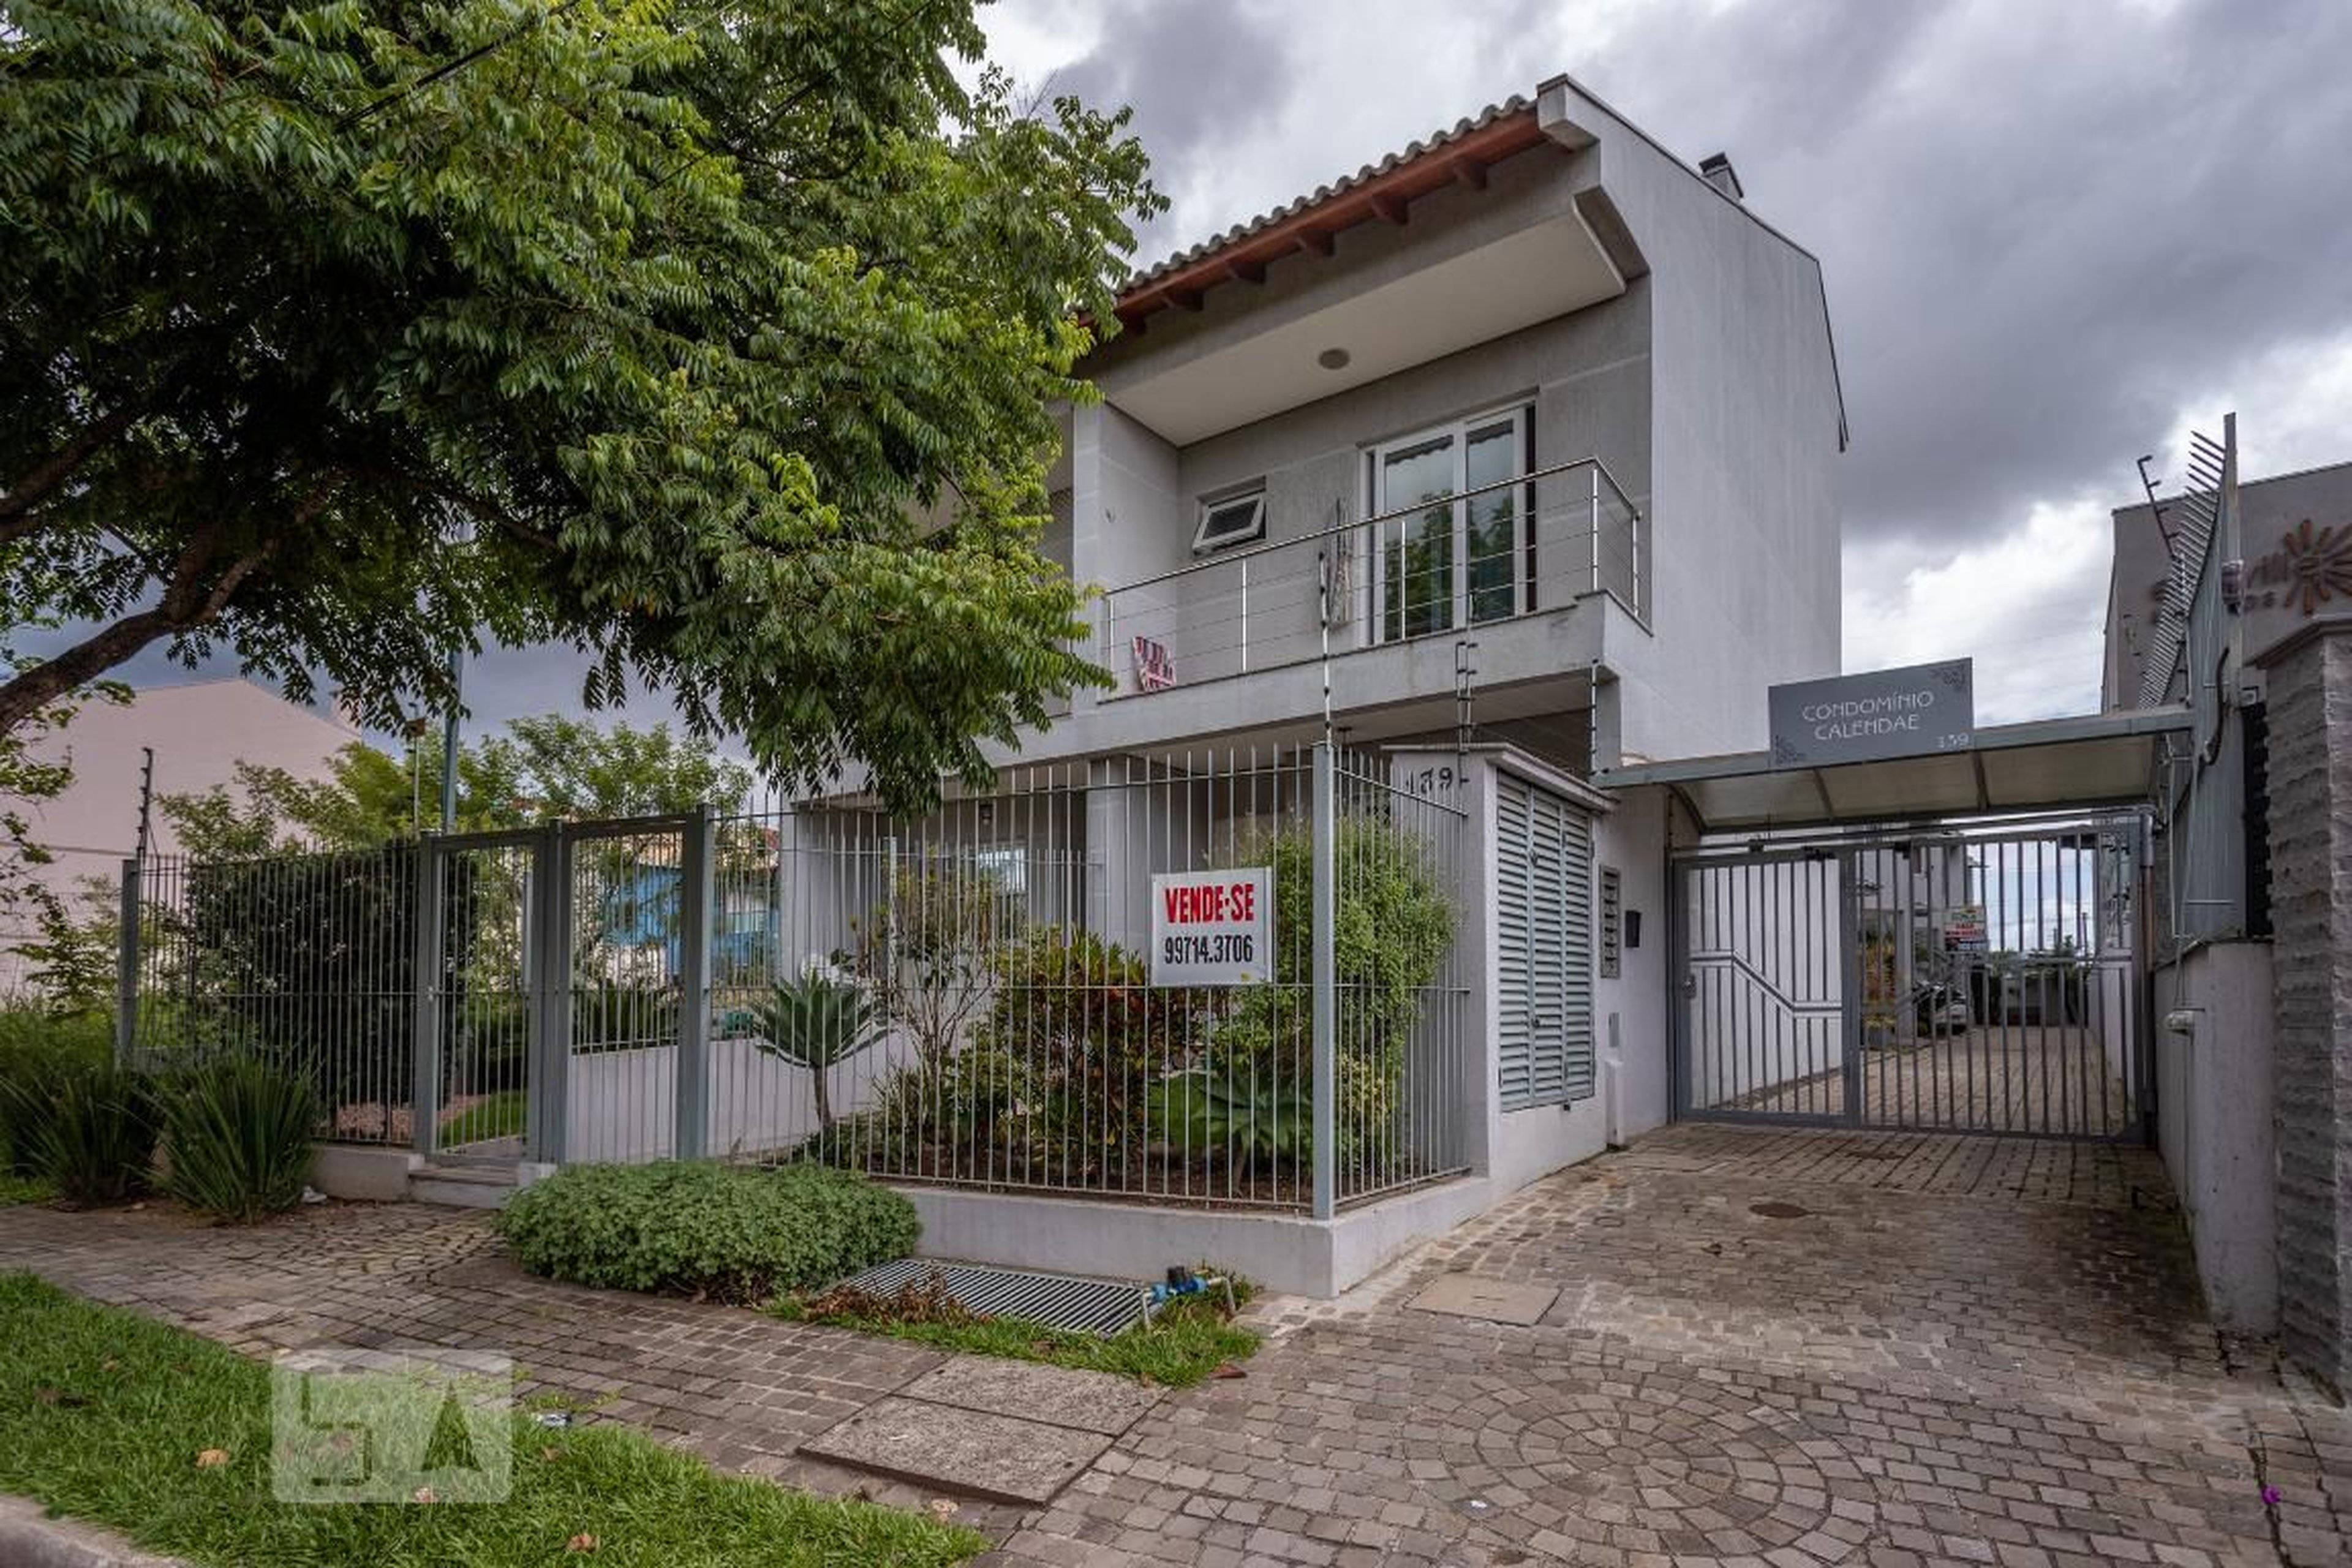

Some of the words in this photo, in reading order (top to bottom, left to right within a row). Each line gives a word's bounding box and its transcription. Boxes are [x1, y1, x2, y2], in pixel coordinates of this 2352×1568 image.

[1802, 690, 1934, 722] CONDOMÍNIO
[1814, 714, 1920, 740] CALENDAE
[1164, 934, 1253, 964] 99714.3706
